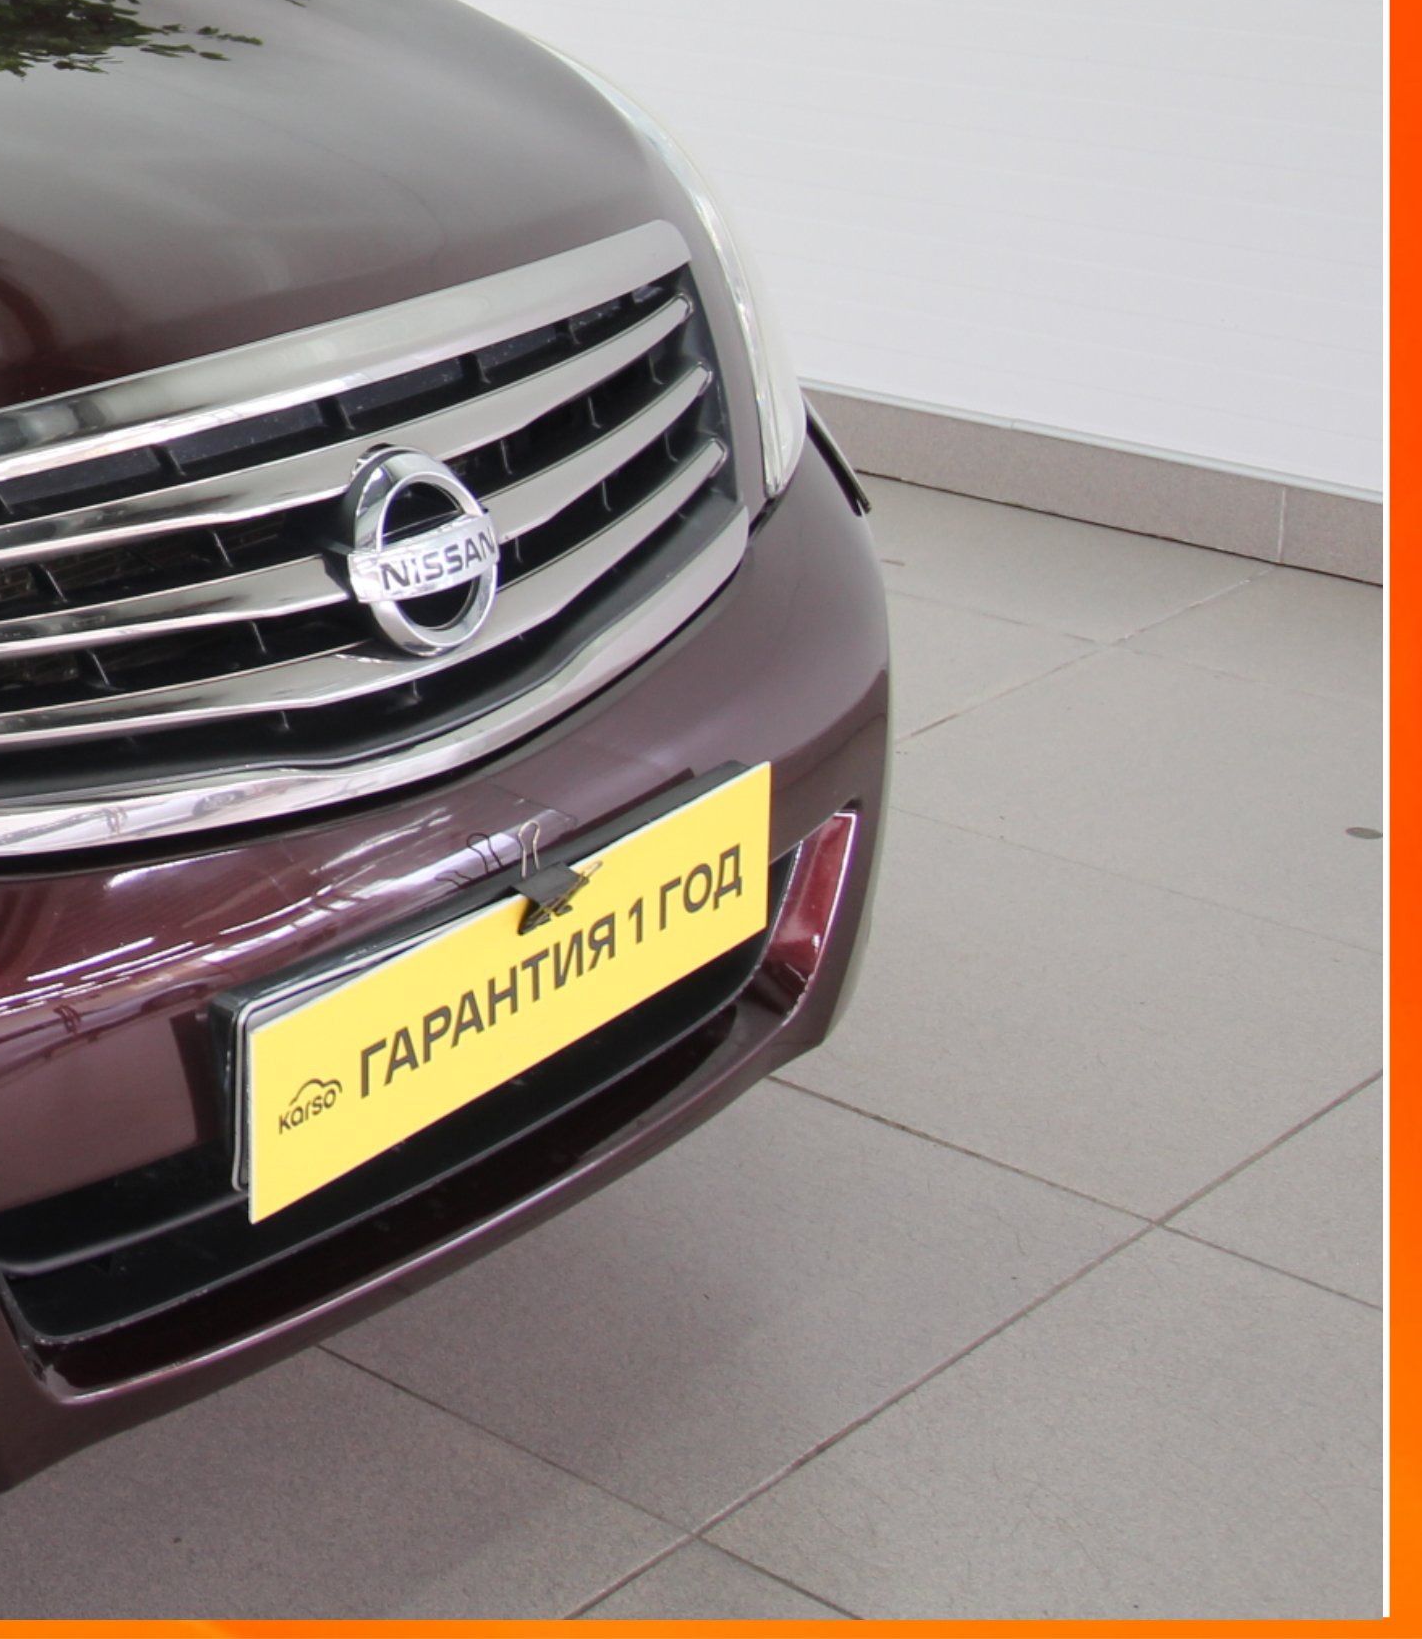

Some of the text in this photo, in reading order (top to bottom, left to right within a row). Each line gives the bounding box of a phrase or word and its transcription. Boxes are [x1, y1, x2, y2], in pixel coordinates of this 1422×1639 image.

[379, 525, 496, 591] NISSAN
[360, 843, 744, 1099] ГАРАНТИЯ 1 ГОД
